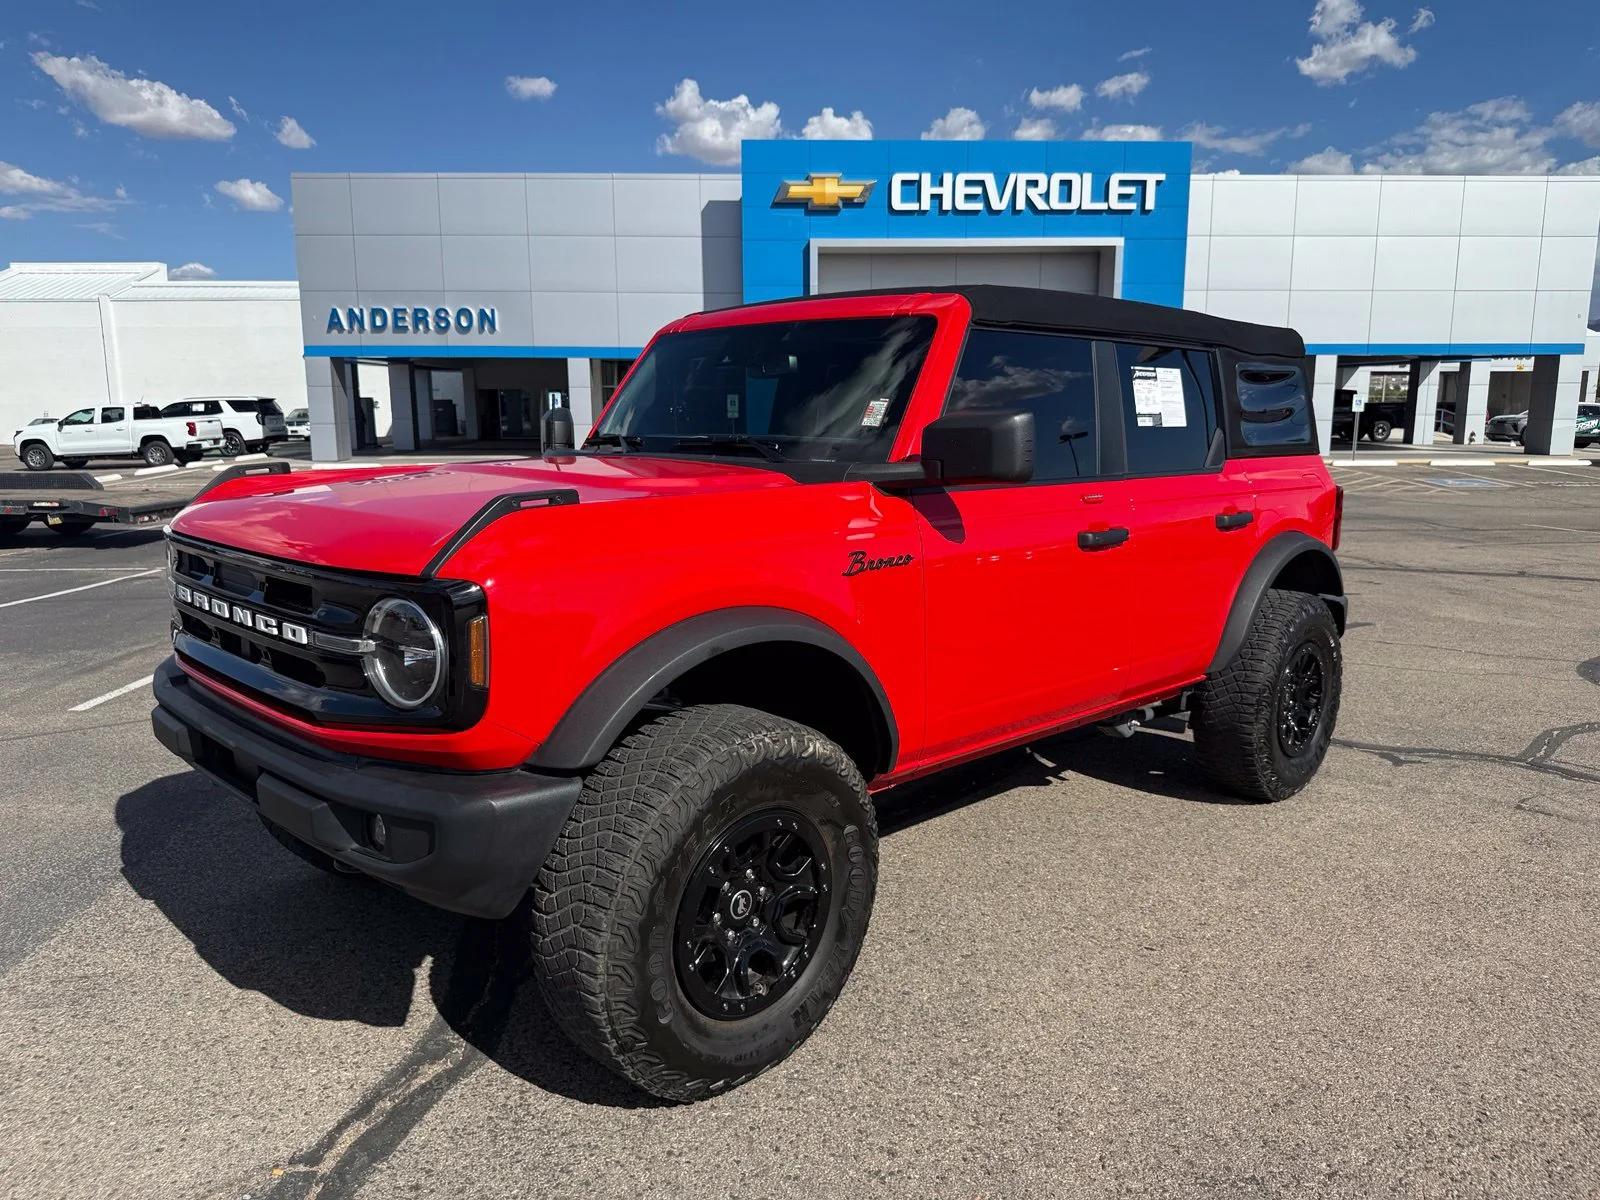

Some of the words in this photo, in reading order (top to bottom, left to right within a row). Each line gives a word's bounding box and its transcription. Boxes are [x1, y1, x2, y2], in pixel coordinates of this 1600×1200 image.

[890, 172, 1167, 213] CHEVROLET
[326, 305, 499, 334] ANDERSON
[841, 550, 915, 577] Bronco
[175, 583, 308, 645] BRONCO
[790, 823, 867, 1034] GOODYEAR
